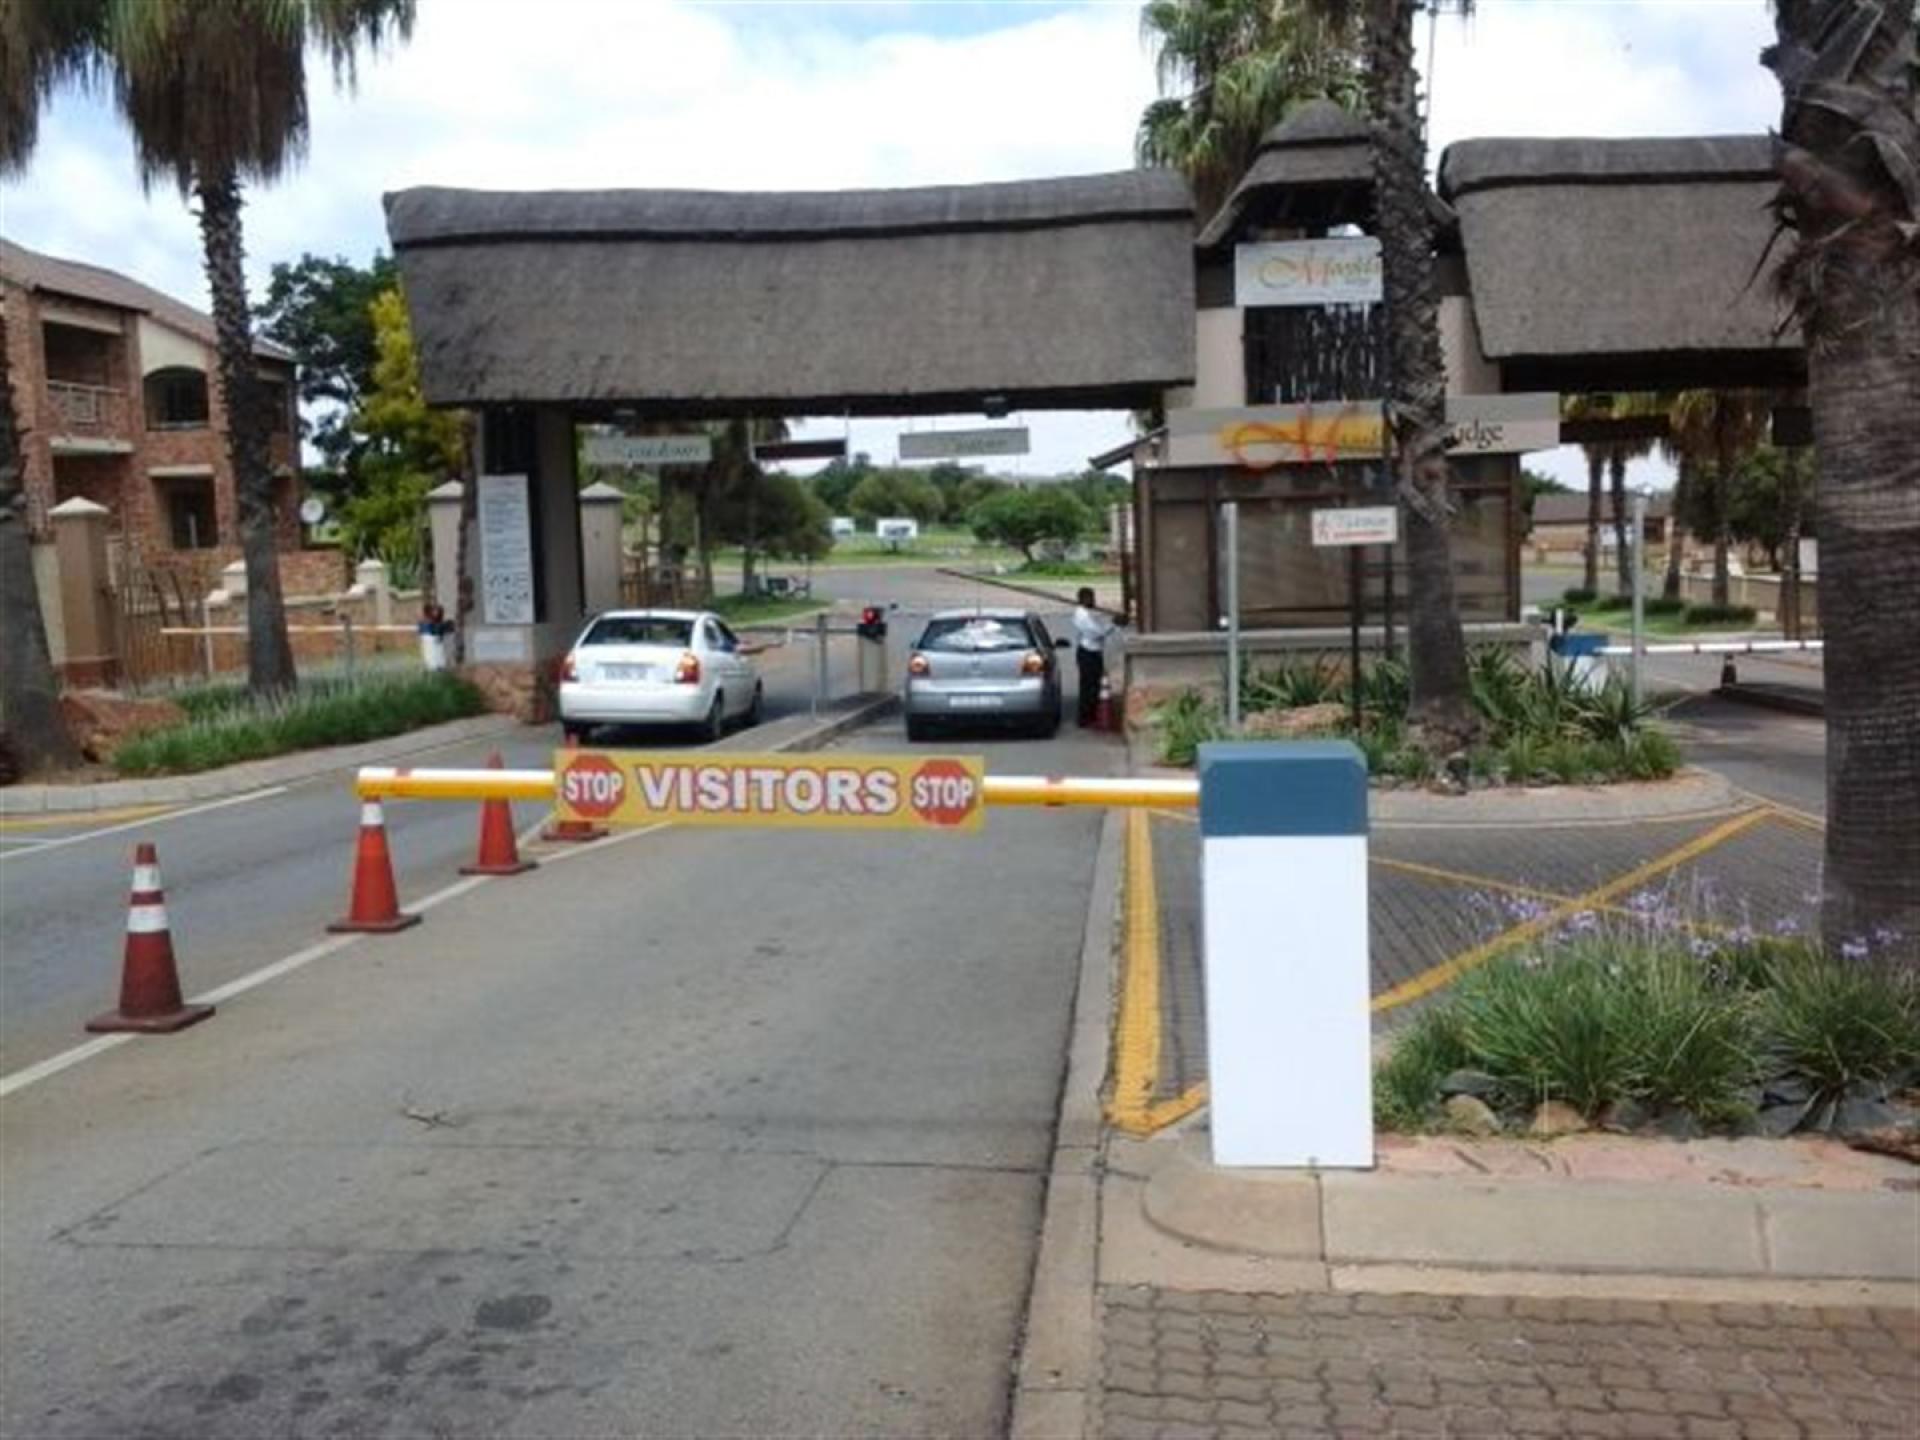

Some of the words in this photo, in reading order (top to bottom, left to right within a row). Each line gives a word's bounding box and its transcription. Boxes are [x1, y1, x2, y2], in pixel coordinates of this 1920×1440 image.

[565, 770, 623, 801] STOP
[636, 764, 900, 814] VISITORS
[912, 776, 974, 809] STOP
